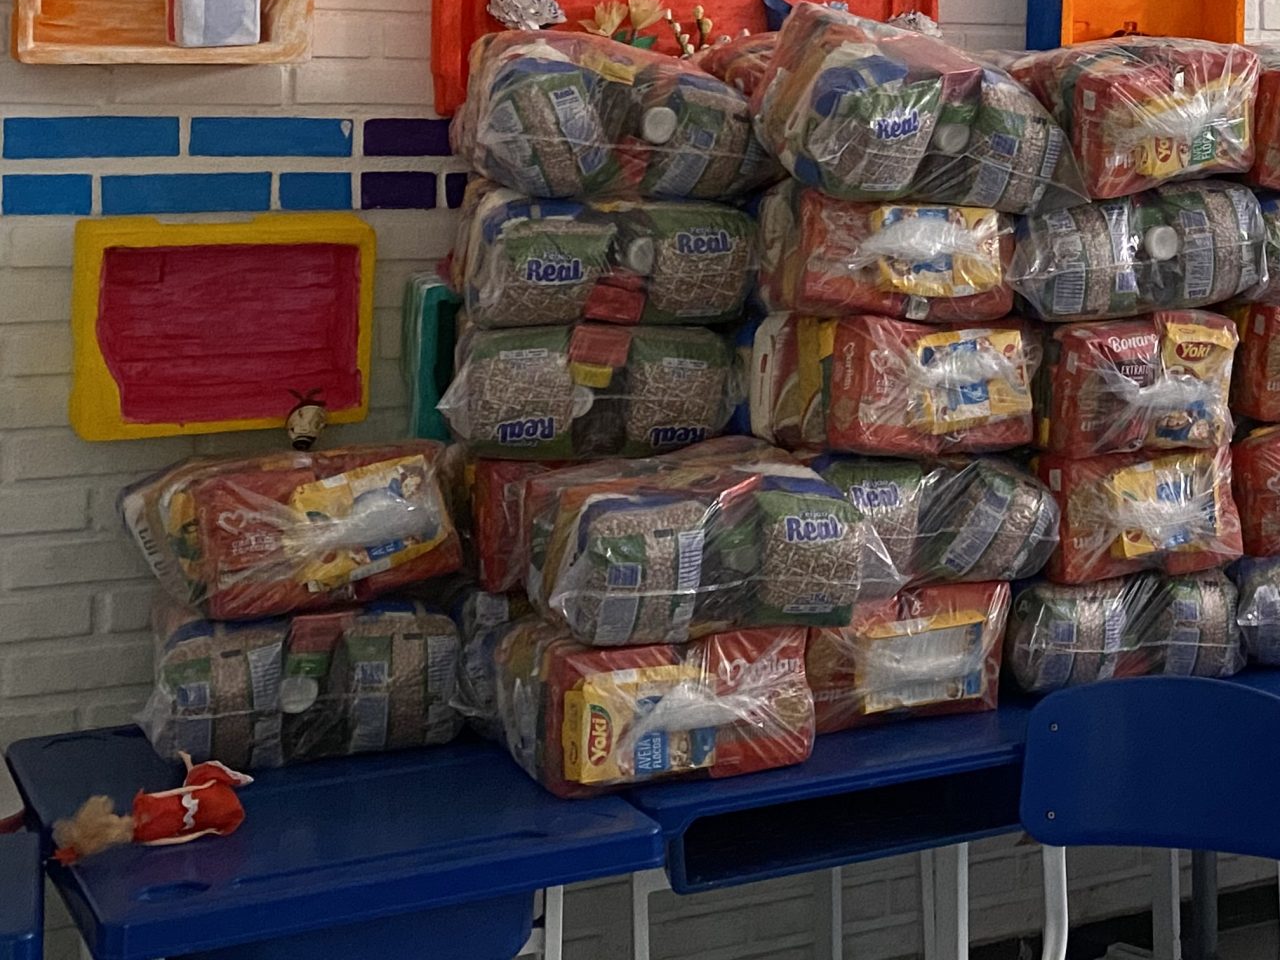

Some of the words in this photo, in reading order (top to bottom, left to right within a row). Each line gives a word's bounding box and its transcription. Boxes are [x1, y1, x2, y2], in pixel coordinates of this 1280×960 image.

[677, 230, 732, 254] Real
[526, 259, 585, 283] Real
[1181, 343, 1211, 358] Yoki
[497, 417, 554, 443] Real
[650, 427, 705, 447] Real
[785, 516, 843, 541] Real
[590, 717, 609, 762] Yoki
[637, 738, 652, 770] AVEIA
[652, 738, 662, 769] FLOCOS
